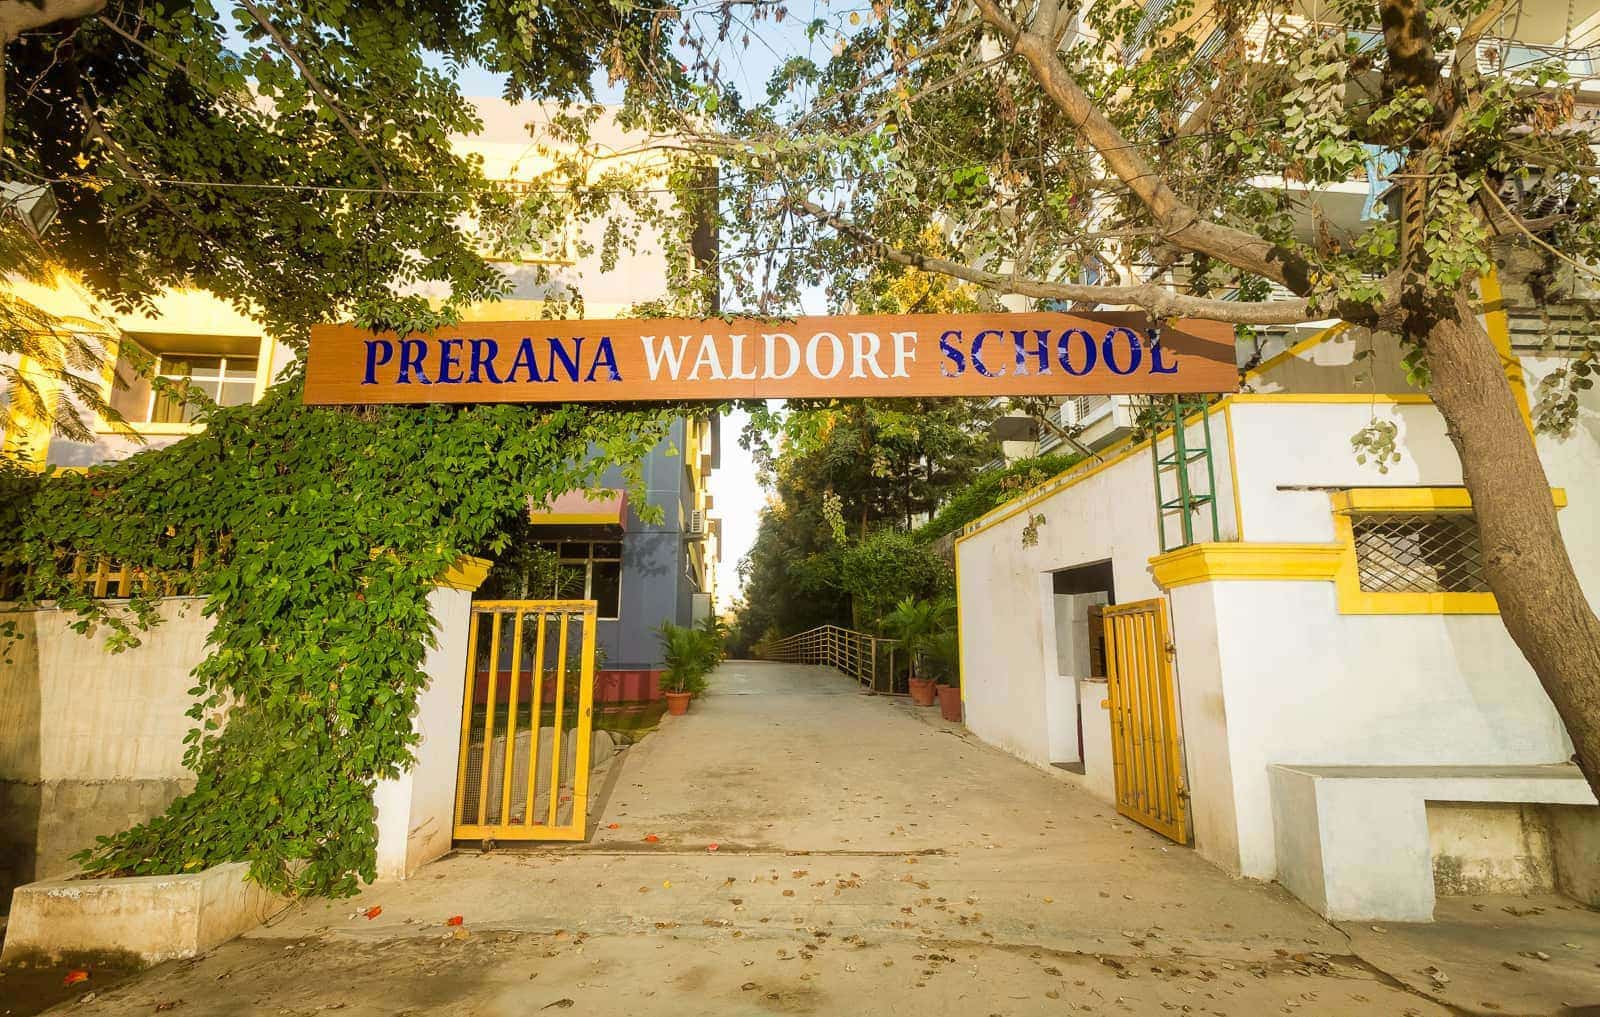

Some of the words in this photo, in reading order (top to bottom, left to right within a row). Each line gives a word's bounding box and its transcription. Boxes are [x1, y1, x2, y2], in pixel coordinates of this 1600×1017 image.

[361, 336, 623, 385] PRERANA
[639, 331, 918, 382] WALDORF
[939, 326, 1179, 378] SCHOOL
